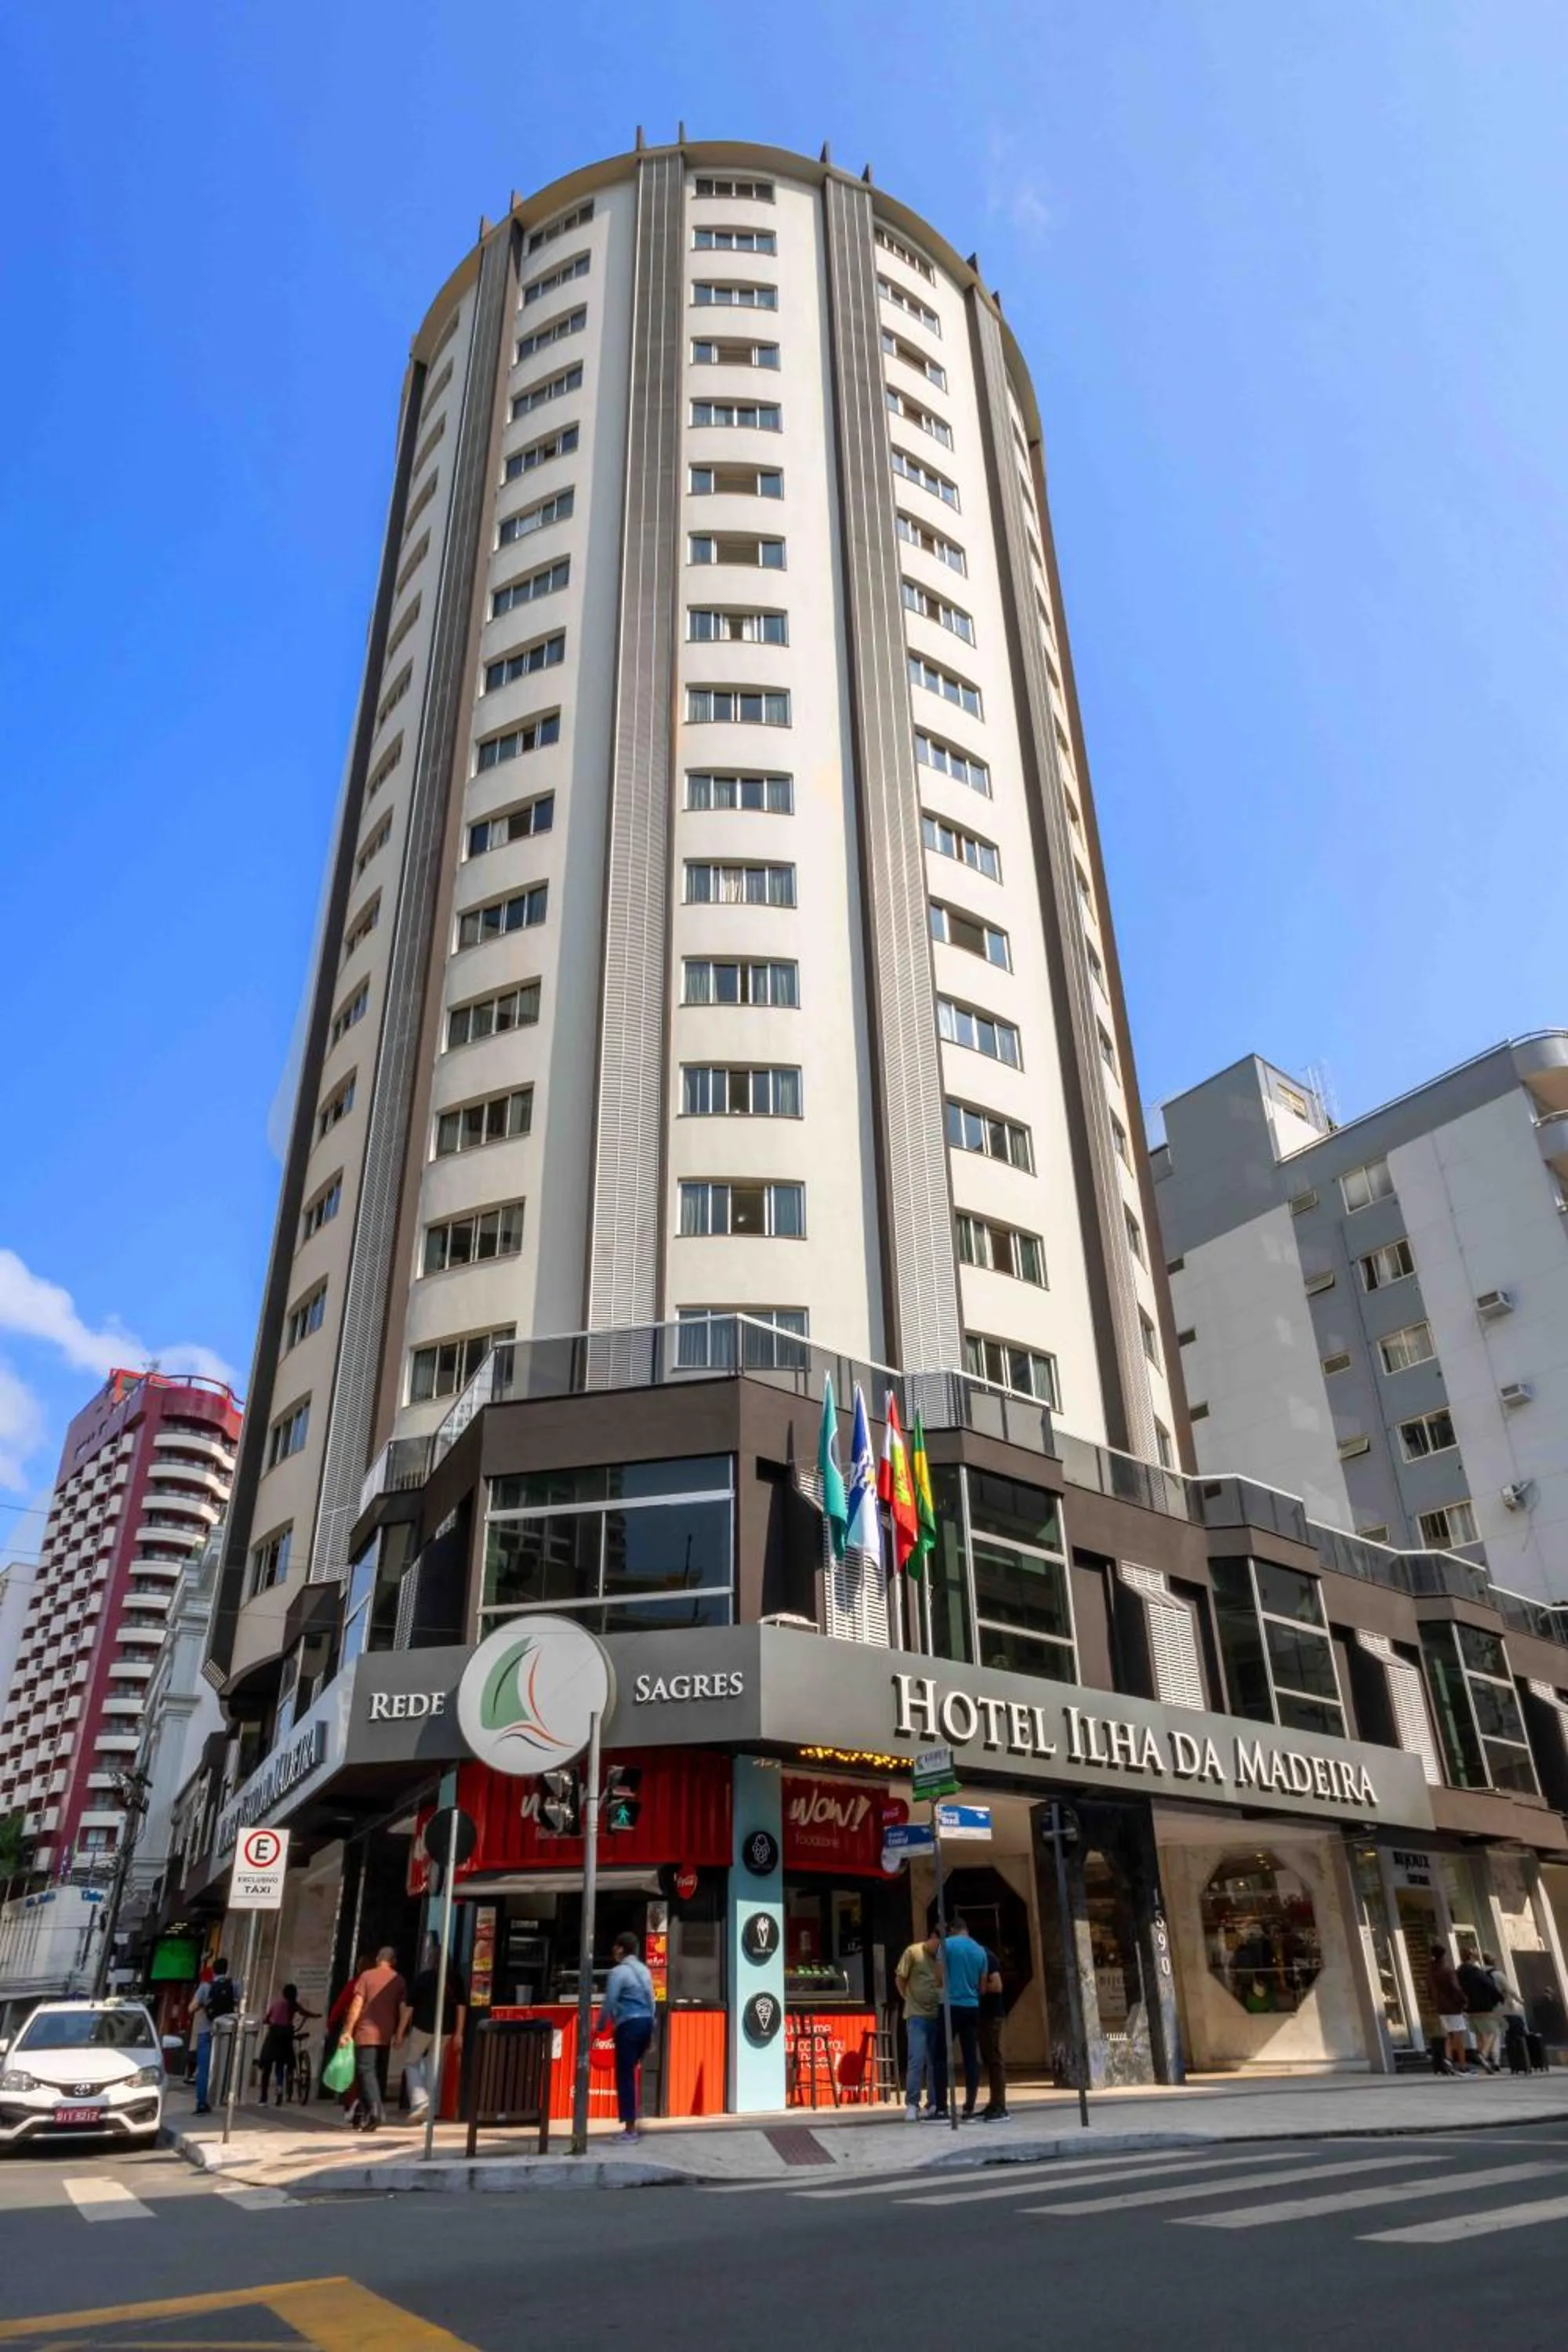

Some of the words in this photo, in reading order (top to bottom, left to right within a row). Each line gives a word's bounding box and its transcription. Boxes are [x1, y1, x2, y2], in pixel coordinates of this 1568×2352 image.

[369, 1693, 445, 1719] REDE
[635, 1672, 744, 1703] SAGRES
[893, 1674, 1056, 1755] HOTEL
[1066, 1706, 1164, 1771] ILHA
[1169, 1730, 1228, 1780] DA
[1236, 1735, 1380, 1803] MADEIRA
[789, 1788, 872, 1831] WOW!
[255, 1838, 270, 1859] E
[238, 1876, 279, 1885] EXCLUSIVO
[1153, 1888, 1171, 1976] 1590
